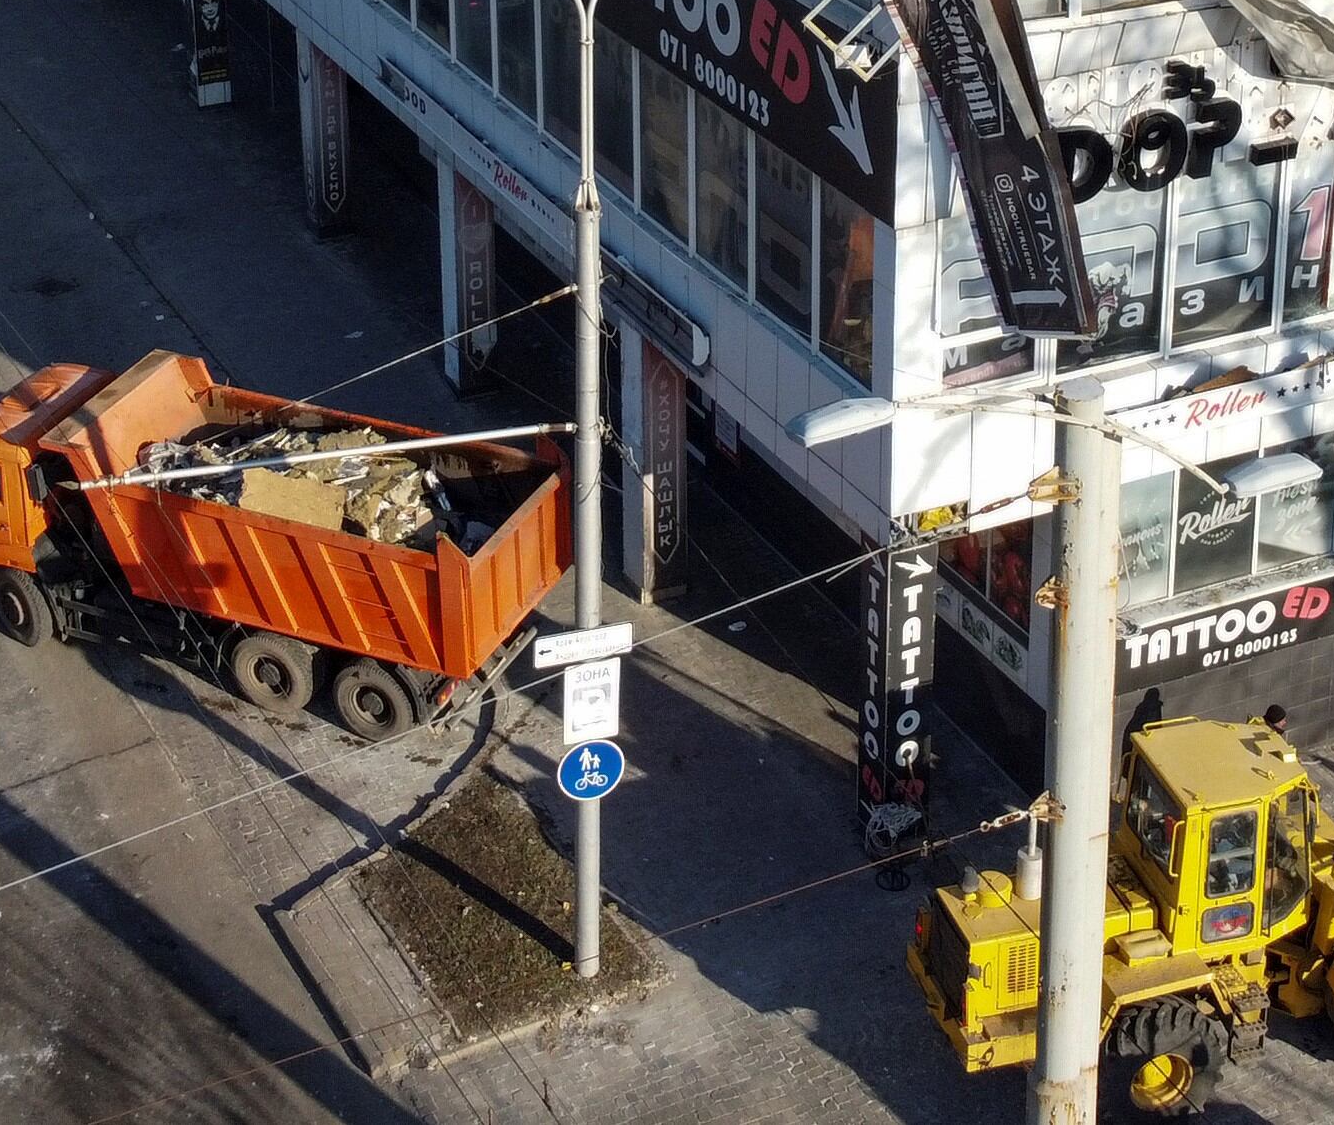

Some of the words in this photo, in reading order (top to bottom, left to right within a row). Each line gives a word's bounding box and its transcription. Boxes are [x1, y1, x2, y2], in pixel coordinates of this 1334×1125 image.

[659, 28, 688, 72] 071
[694, 52, 770, 127] 8000123
[327, 140, 340, 202] ВКУСНО
[1020, 164, 1040, 183] 4
[1028, 190, 1064, 286] ЭТАЖ
[656, 460, 674, 548] ШАШЛЫК
[864, 574, 880, 761] TATTOO
[1125, 600, 1277, 669] TATTOO
[1281, 586, 1331, 619] ED
[1202, 649, 1229, 668] 071
[1234, 628, 1298, 659] 8000123
[575, 667, 611, 684] ЗОНА
[893, 583, 924, 768] TATTOO
